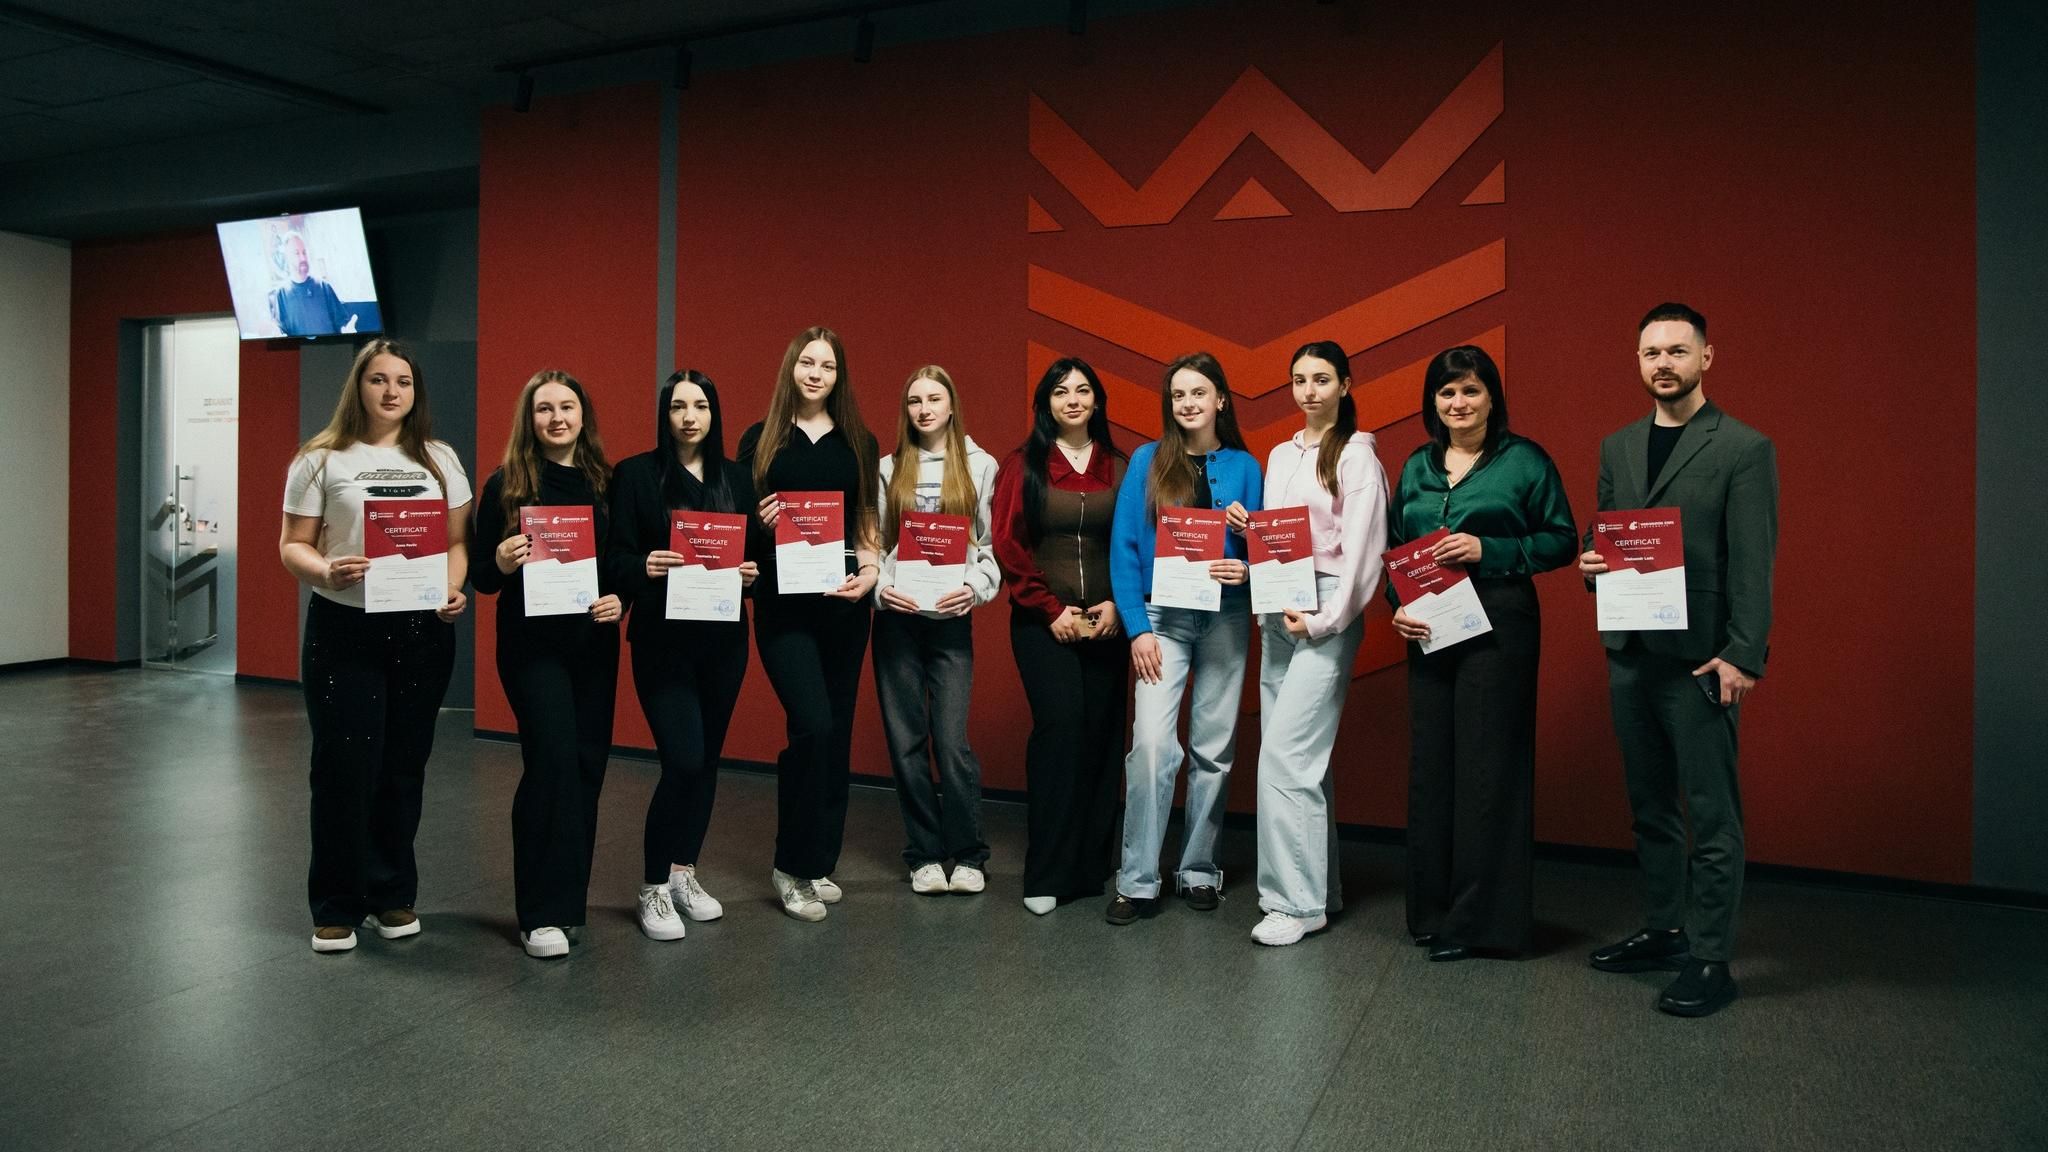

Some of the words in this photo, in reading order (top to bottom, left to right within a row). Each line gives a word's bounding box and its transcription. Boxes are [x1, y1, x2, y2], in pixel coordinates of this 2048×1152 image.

[791, 515, 829, 523] CERTIFICATE
[384, 526, 428, 534] CERTIFICATE
[539, 531, 578, 539] CERTIFICATE
[1172, 531, 1209, 540] CERTIFICATE
[1261, 532, 1296, 542] CERTIFICATE
[688, 537, 728, 546] CERTIFICATE
[915, 535, 952, 545] CERTIFICATE
[1615, 538, 1661, 547] CERTIFICATE
